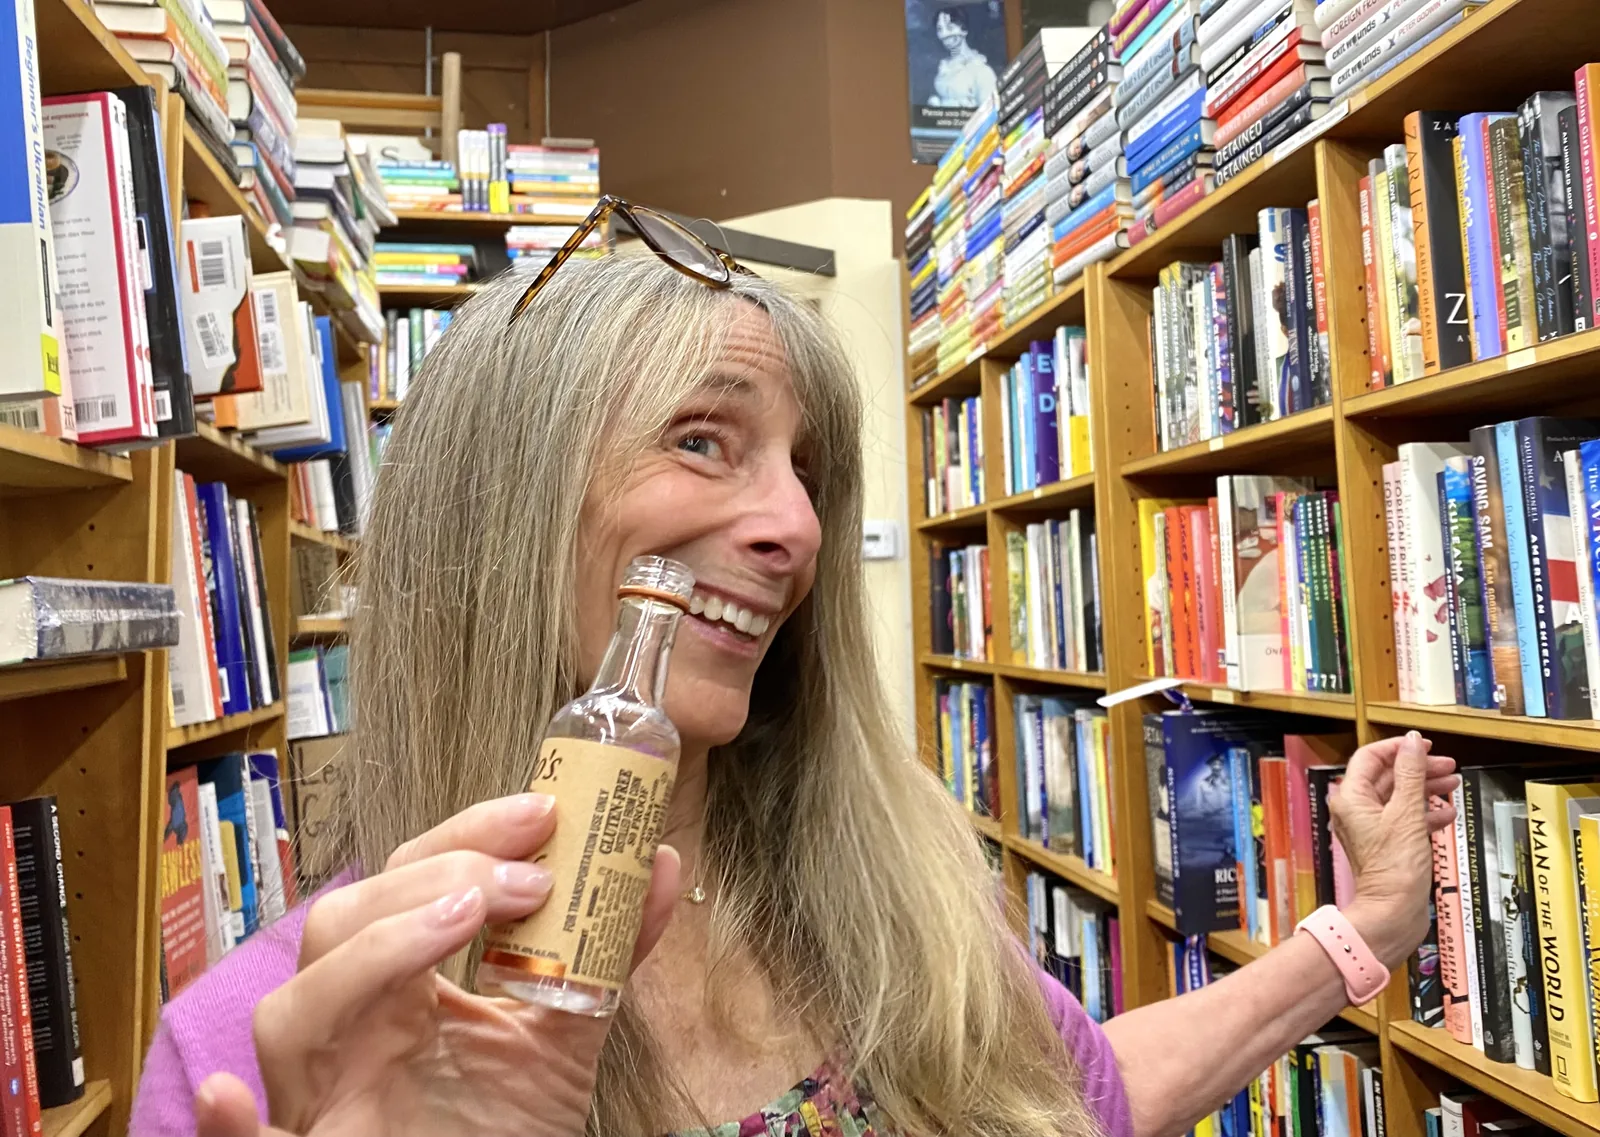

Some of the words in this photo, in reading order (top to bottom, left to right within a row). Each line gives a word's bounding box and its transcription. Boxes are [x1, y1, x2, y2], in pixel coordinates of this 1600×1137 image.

[1330, 8, 1361, 38] FOREIGN
[1332, 42, 1347, 60] exit
[1346, 18, 1376, 47] wounds
[1398, 18, 1417, 37] PETER
[1416, 1, 1441, 23] GODWIN
[1337, 67, 1351, 85] exit
[1351, 43, 1381, 72] wounds
[1577, 78, 1588, 122] Kissing
[25, 36, 39, 133] Beginner's
[33, 142, 46, 229] Ukrainian
[1215, 120, 1263, 166] DETAINED
[1496, 127, 1506, 166] BENDING
[1562, 131, 1568, 144] AN
[1581, 125, 1590, 156] Girls
[1216, 143, 1263, 186] DETAINED
[1405, 125, 1425, 234] ZARIFA
[1461, 154, 1473, 188] This
[1563, 147, 1572, 184] UNRULED
[1583, 158, 1590, 173] on
[1499, 169, 1508, 204] TOWARD
[1566, 185, 1574, 210] BODY
[1584, 176, 1596, 226] Shabbat
[1502, 206, 1510, 224] THE
[1537, 189, 1546, 235] Daughter
[1303, 232, 1313, 273] Griffin
[1310, 217, 1320, 267] Children
[1361, 231, 1372, 266] VOICES
[1315, 269, 1322, 282] of
[1419, 244, 1428, 285] ZARIFA
[1305, 274, 1313, 309] Dunne
[1315, 283, 1326, 323] Radium
[1422, 288, 1432, 341] GHAFARI
[1472, 455, 1490, 513] SAVING
[1523, 435, 1533, 482] AQUILINO
[1528, 483, 1539, 523] GONELL
[1587, 463, 1599, 493] The
[1395, 479, 1405, 543] FOREIGN
[1505, 505, 1514, 528] But
[1384, 481, 1394, 543] FOREIGN
[1389, 546, 1399, 582] FRUIT
[1447, 497, 1465, 586] KULEANA
[1479, 515, 1494, 549] SAM
[1508, 532, 1518, 558] You
[1399, 546, 1409, 582] FRUIT
[1510, 561, 1521, 600] Don't
[1446, 567, 1455, 626] AMERICAN
[1451, 629, 1460, 672] SHIELD
[1487, 588, 1499, 633] GOODWIN
[1514, 603, 1525, 634] Look
[1530, 534, 1545, 614] AMERICAN
[1538, 619, 1551, 678] SHIELD
[1518, 640, 1529, 674] Arab
[594, 787, 610, 813] ONLY
[1464, 779, 1471, 788] A
[51, 804, 57, 813] A
[590, 812, 603, 831] USE
[598, 767, 632, 855] GLUTEN-FREE
[613, 816, 632, 853] DISTILLED
[623, 796, 637, 817] FROM
[630, 785, 650, 831] PROOF
[1464, 790, 1476, 842] MILLION
[1531, 803, 1542, 812] A
[51, 815, 62, 861] SECOND
[1531, 818, 1551, 871] MAN
[567, 831, 598, 914] TRANSPORTATION
[1437, 843, 1450, 881] TELL
[1468, 844, 1479, 881] TIMES
[8, 863, 19, 914] INCLUSIVE
[56, 862, 67, 908] CHANCE
[1461, 871, 1473, 933] FALLING
[1472, 884, 1481, 904] WE
[1538, 874, 1549, 897] OF
[562, 913, 577, 932] FOR
[1443, 902, 1452, 928] AMY
[1474, 907, 1483, 931] CRY
[1540, 901, 1553, 930] THE
[13, 917, 24, 964] SOCRATIC
[1503, 919, 1518, 985] Hereafter
[1446, 936, 1459, 990] GRIFFIN
[1543, 936, 1565, 1022] WORLD
[4, 973, 12, 1015] Freedom
[18, 968, 29, 1017] TEACHING
[1374, 1080, 1381, 1095] AN
